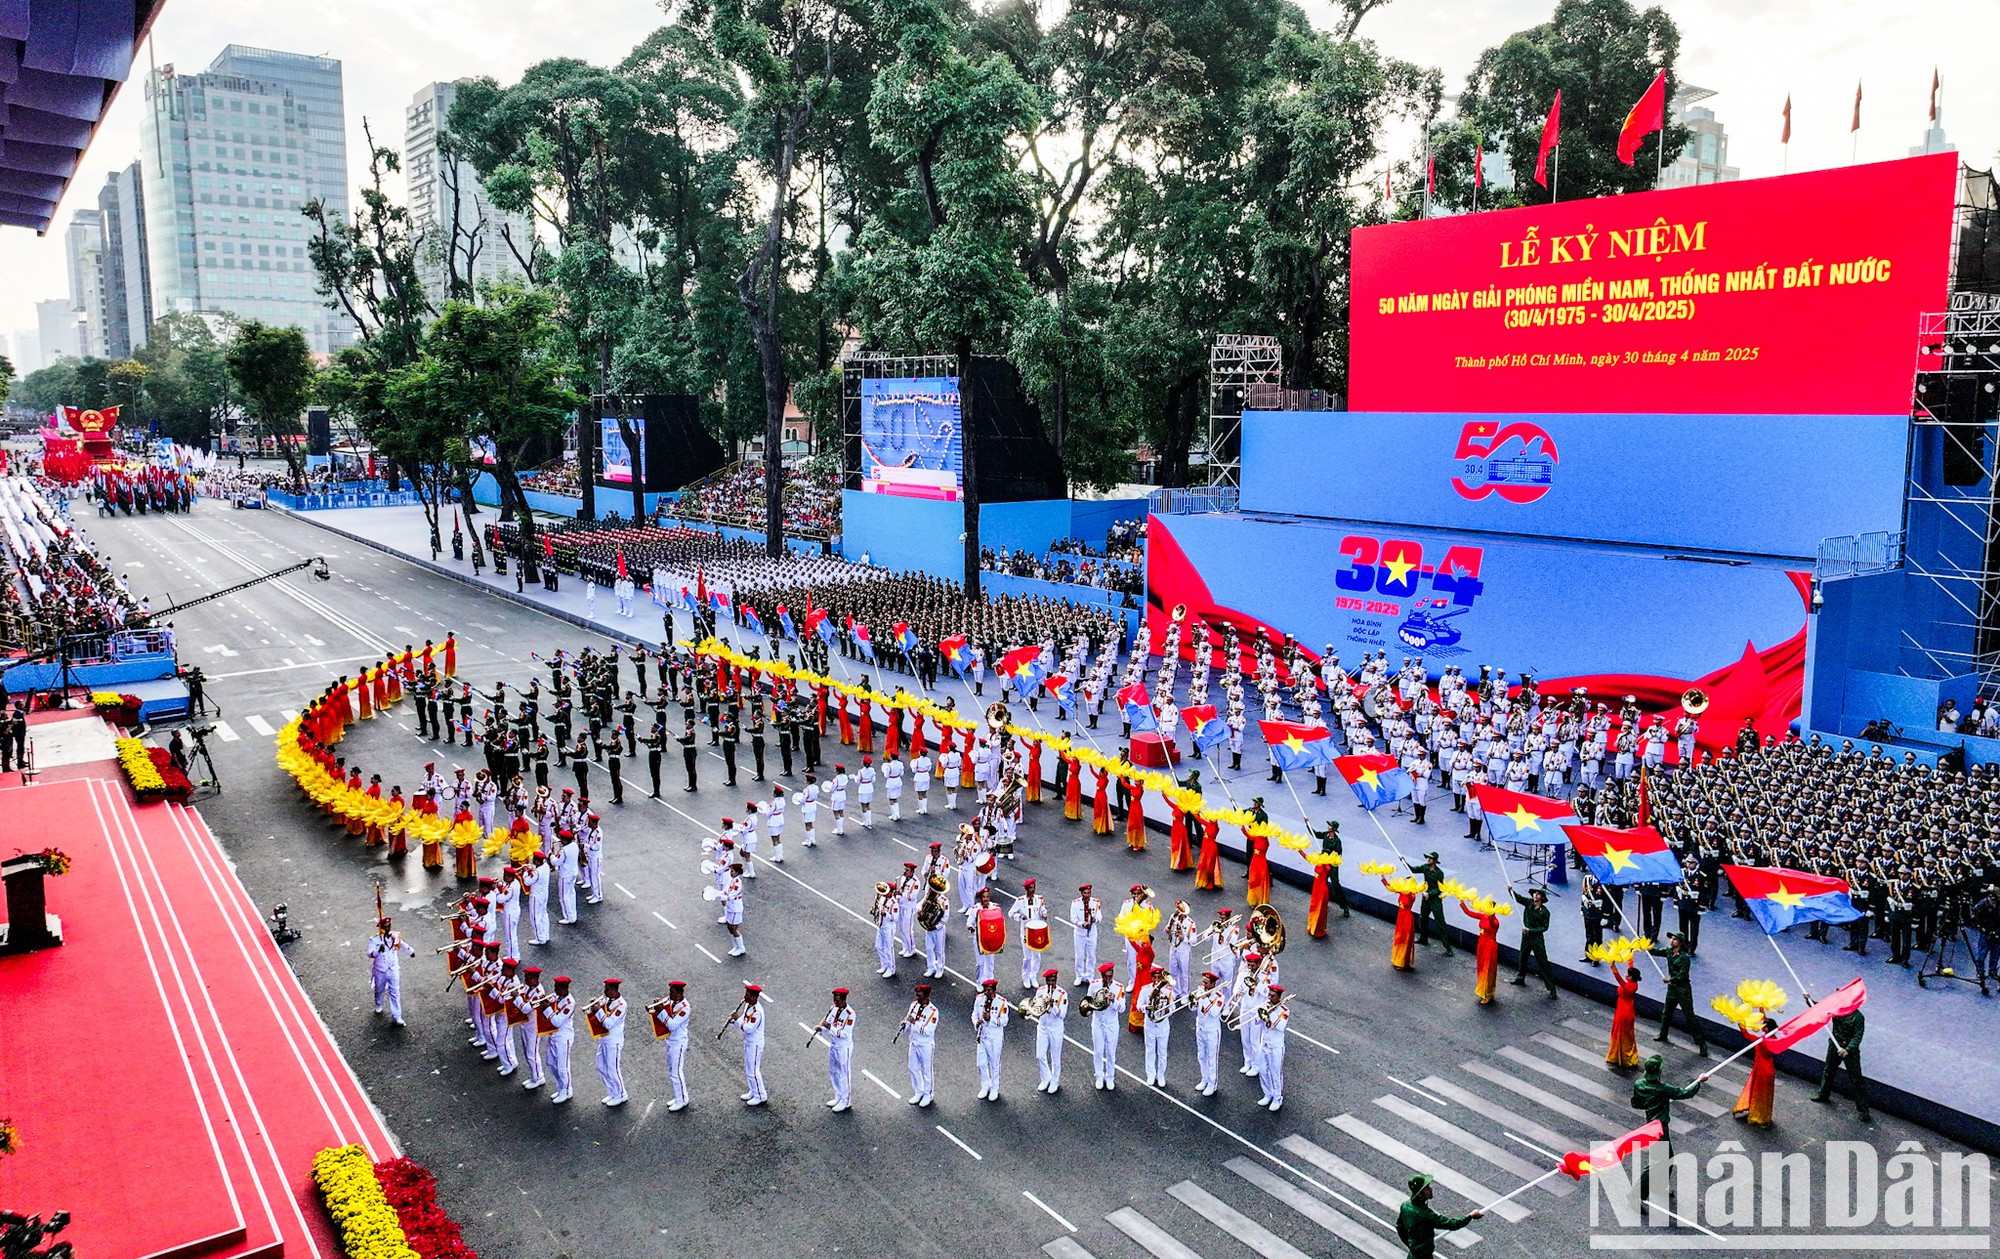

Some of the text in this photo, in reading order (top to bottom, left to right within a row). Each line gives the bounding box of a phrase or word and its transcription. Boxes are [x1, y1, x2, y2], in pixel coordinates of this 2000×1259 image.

[1500, 216, 1708, 268] LỄ KỶ NIỆM
[1379, 255, 1892, 315] 50 NĂM NGÀY GIẢI PHÓNG MIỀN NAM, THỐNG NHẤT ĐẤT NƯỚC
[1503, 305, 1586, 330] (30/4/1975
[1601, 299, 1696, 323] 30/4/2025)
[1455, 347, 1760, 370] Thành phố Hồ Chí Minh, ngày 30 tháng 4 năm 2025
[1450, 420, 1559, 504] 50
[1465, 464, 1483, 475] 30.4
